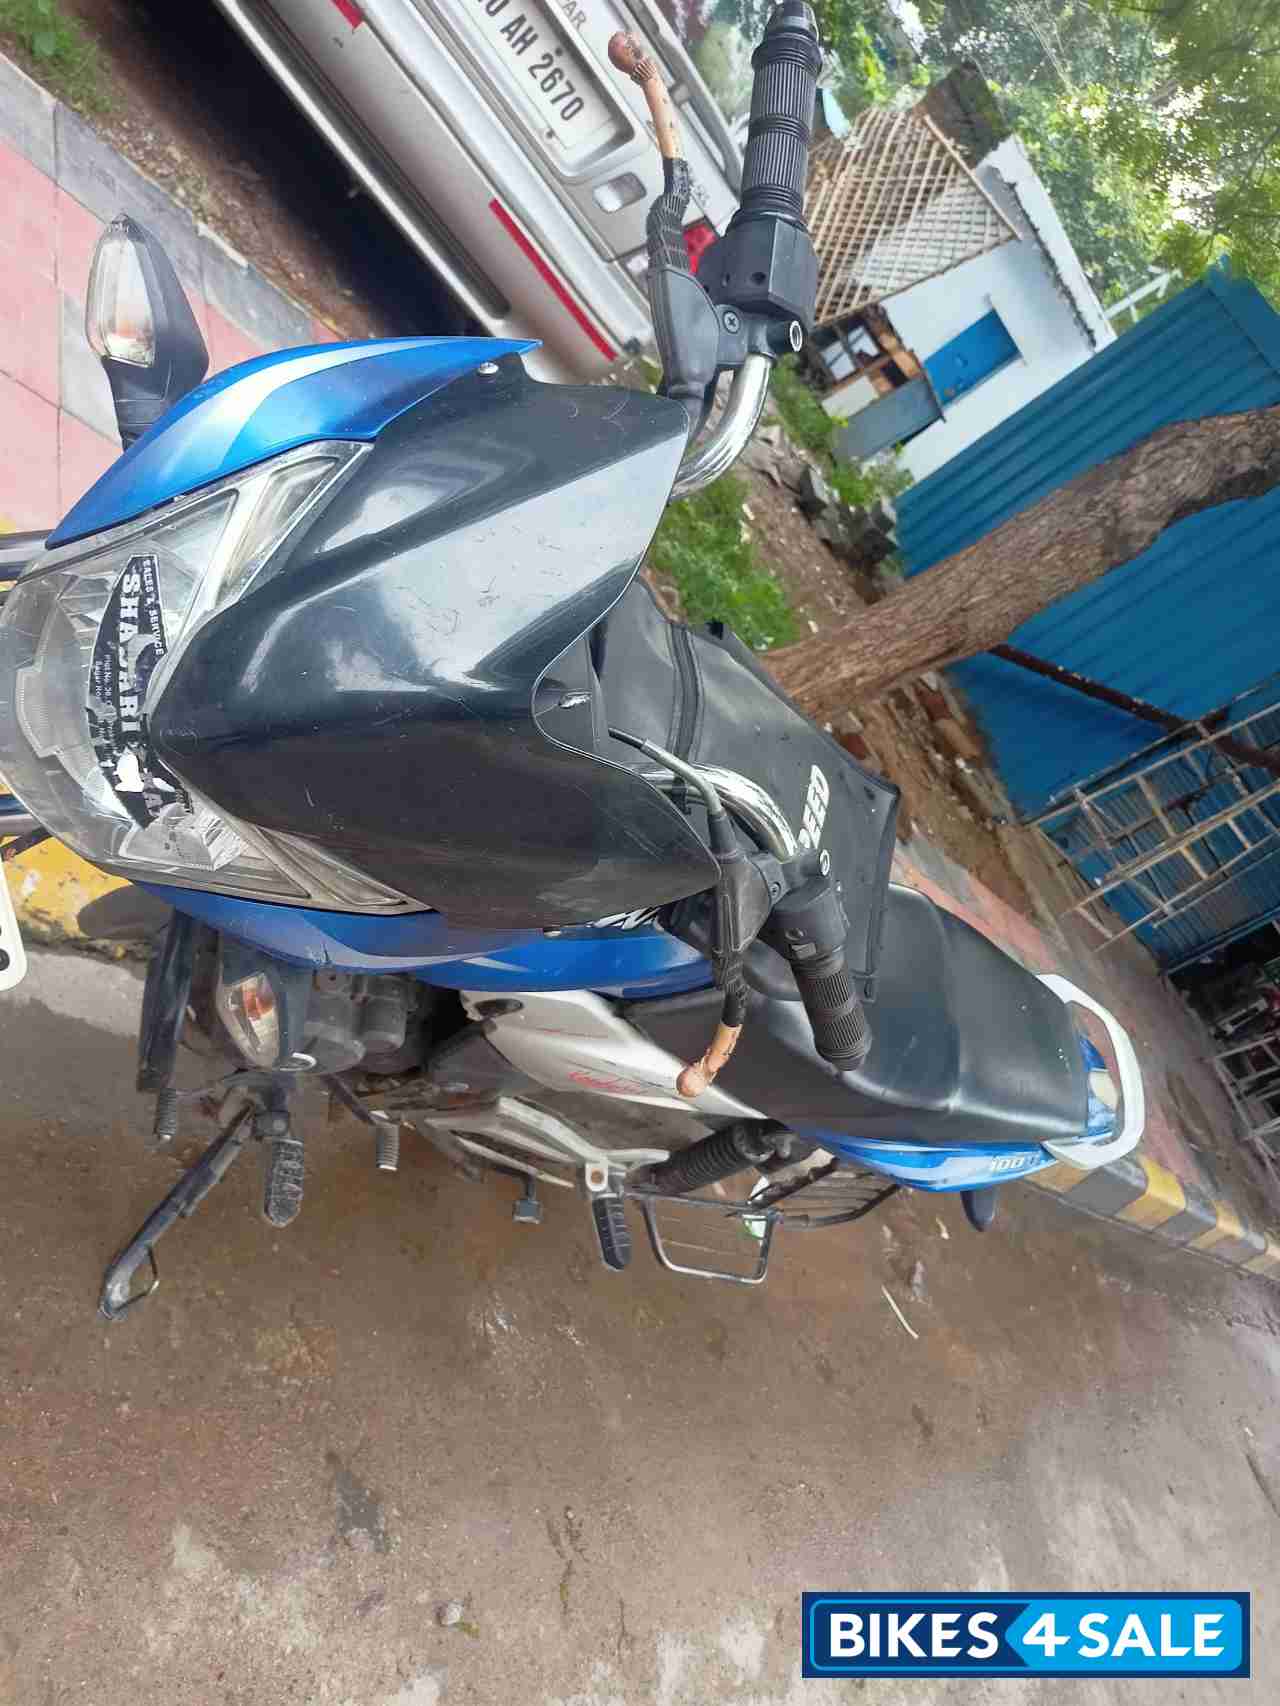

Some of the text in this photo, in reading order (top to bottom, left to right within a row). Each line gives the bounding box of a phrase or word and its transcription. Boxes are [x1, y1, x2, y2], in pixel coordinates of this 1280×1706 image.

[562, 0, 587, 31] AR
[500, 14, 539, 56] AH
[527, 52, 585, 121] 2670
[148, 609, 165, 655] SERVICE
